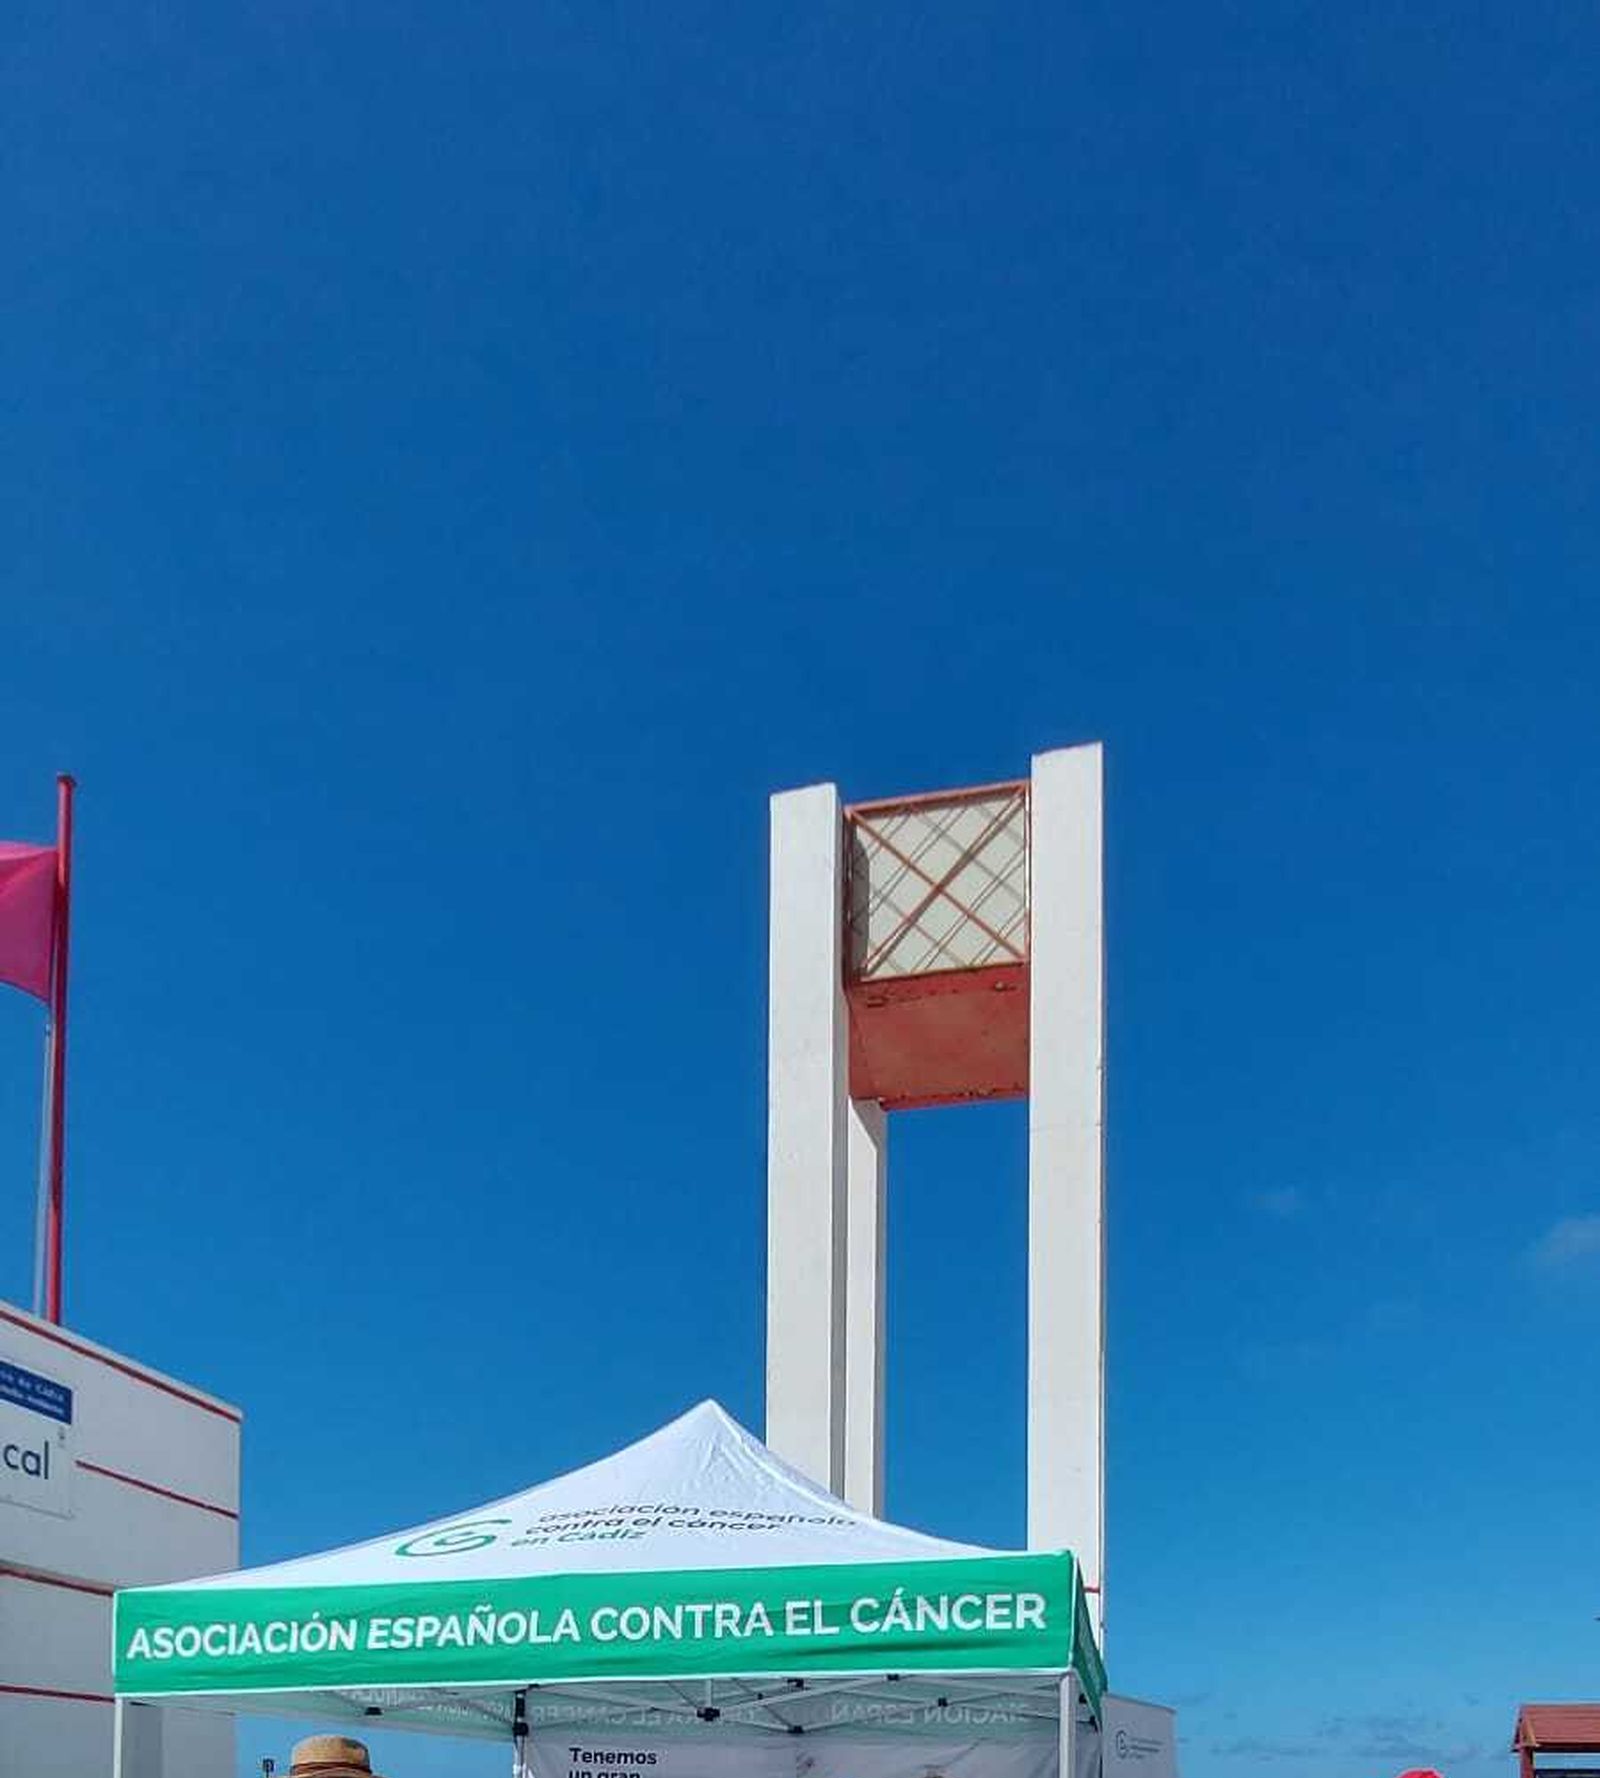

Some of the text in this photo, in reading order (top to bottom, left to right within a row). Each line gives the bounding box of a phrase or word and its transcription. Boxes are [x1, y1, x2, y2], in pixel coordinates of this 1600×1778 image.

[526, 1517, 624, 1535] contra
[631, 1516, 664, 1528] el
[126, 1587, 1047, 1660] ASOCIACIÓN ESPAÑOLA CONTRA EL CÁNCER
[568, 1747, 657, 1764] Tenemos
